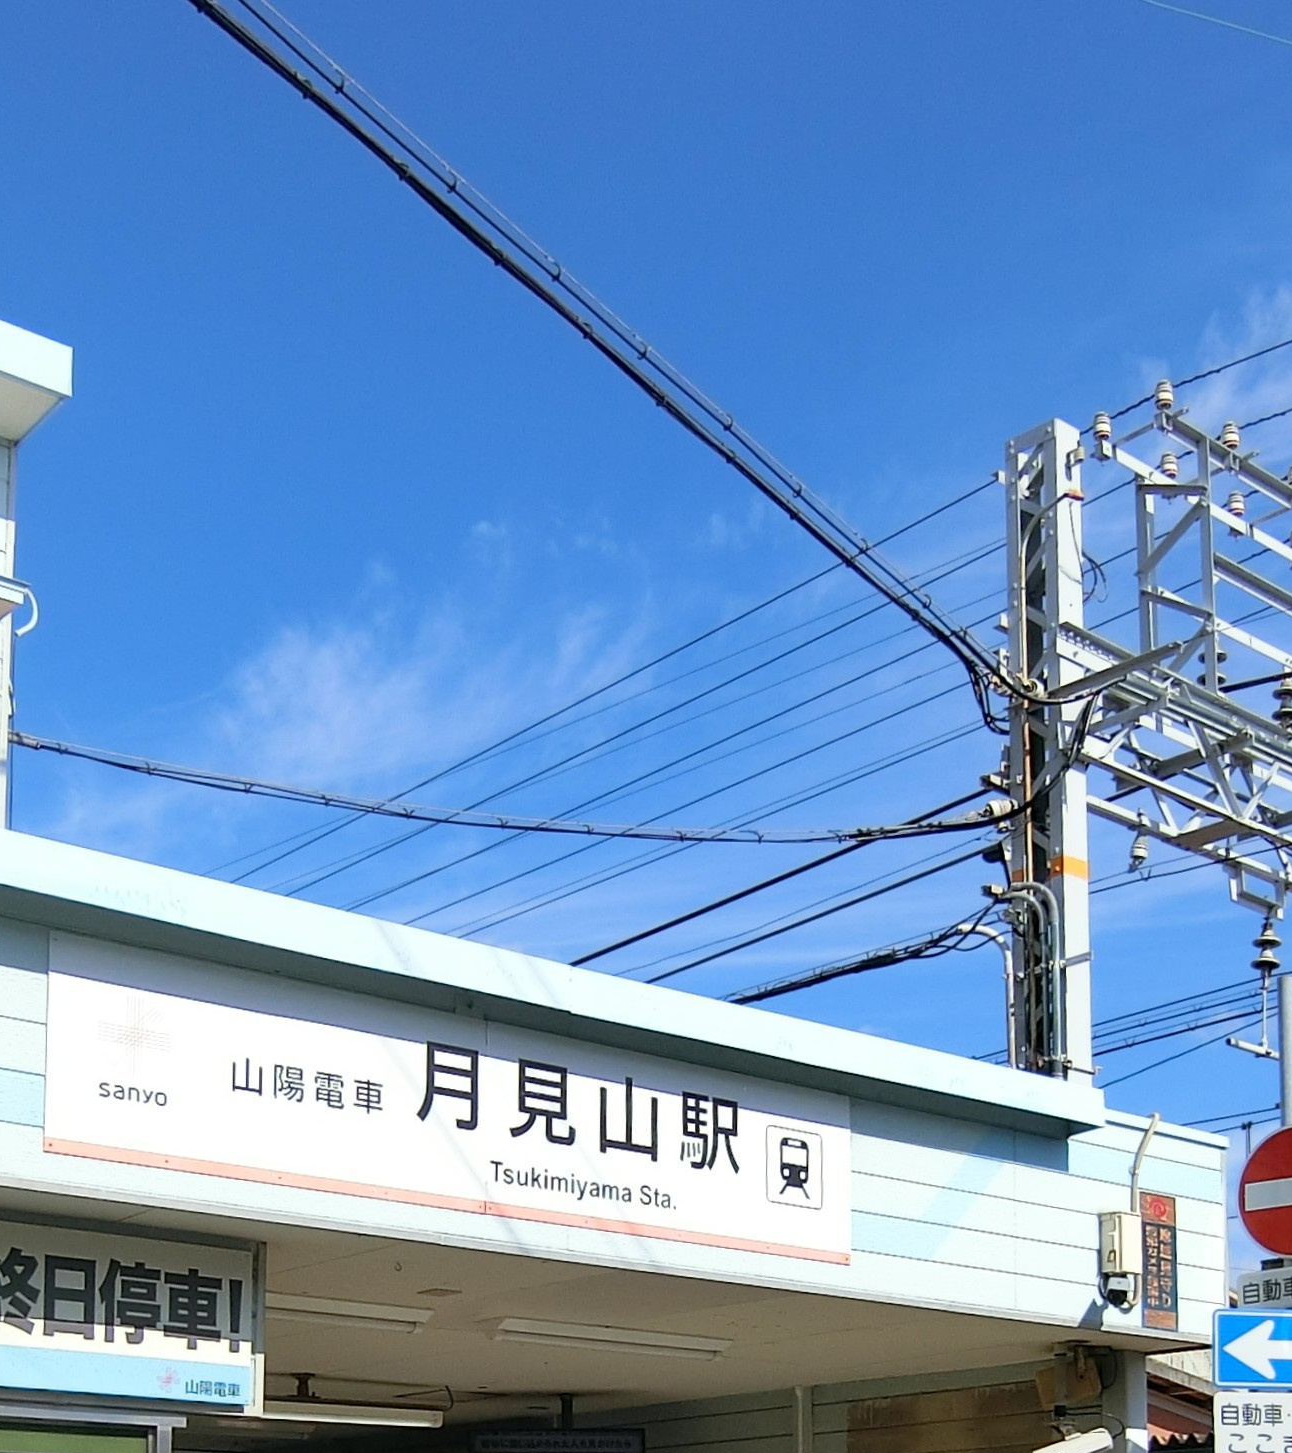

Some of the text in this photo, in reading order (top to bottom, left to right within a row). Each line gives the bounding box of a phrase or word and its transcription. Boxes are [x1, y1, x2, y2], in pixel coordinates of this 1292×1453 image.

[97, 1080, 169, 1108] sanyo
[230, 1057, 384, 1116] 山陽電車
[416, 1041, 741, 1175] 月見山駅
[489, 1160, 677, 1212] Tsukimiyama Sta.
[184, 1378, 241, 1399] 山陽電車
